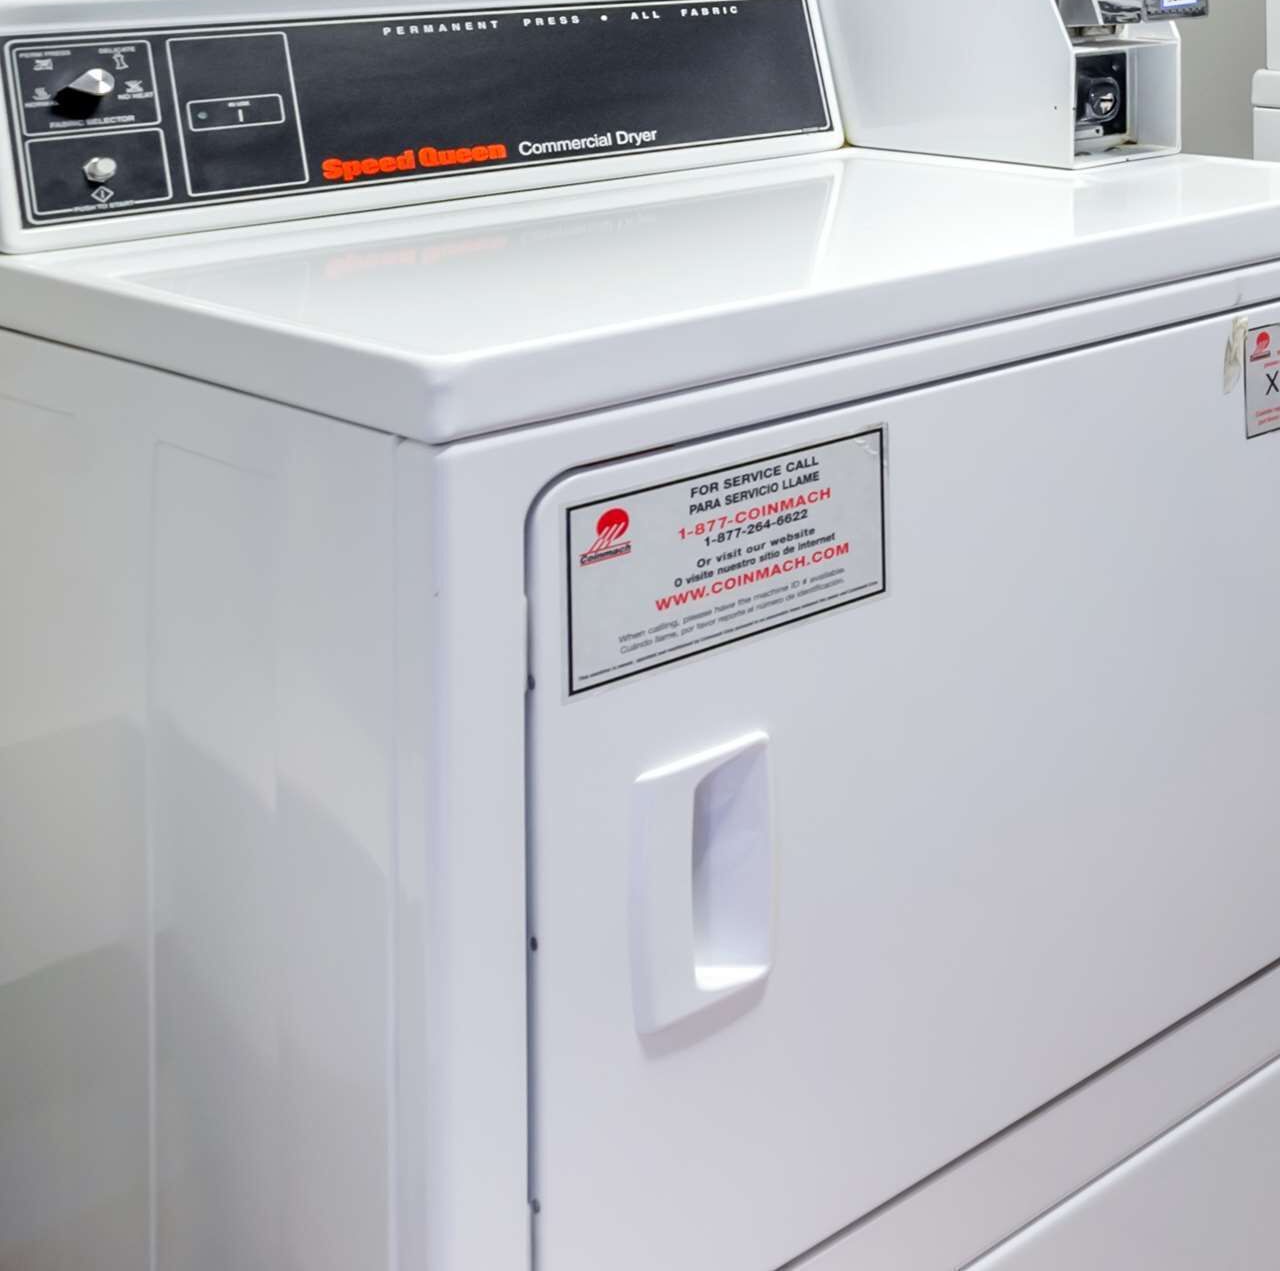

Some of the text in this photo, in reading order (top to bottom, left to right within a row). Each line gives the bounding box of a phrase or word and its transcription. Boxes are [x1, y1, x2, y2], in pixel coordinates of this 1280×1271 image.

[382, 5, 739, 37] PERMANENT PRESS ALL FABRIC
[321, 128, 658, 181] Speed Queen Commercial Dryer
[689, 471, 820, 515] PARA SERVICIO LLAME
[690, 456, 820, 498] FOR SERVICE CALL
[678, 488, 831, 540] 1-877-COINMACH
[704, 509, 808, 546] 1-877-264-6622
[674, 533, 836, 588] O visite nuestro sitio de internet
[697, 527, 816, 568] Or visit our website
[655, 542, 850, 612] WWW.COINMACH.COM
[618, 630, 646, 644] When
[753, 585, 790, 602] machine
